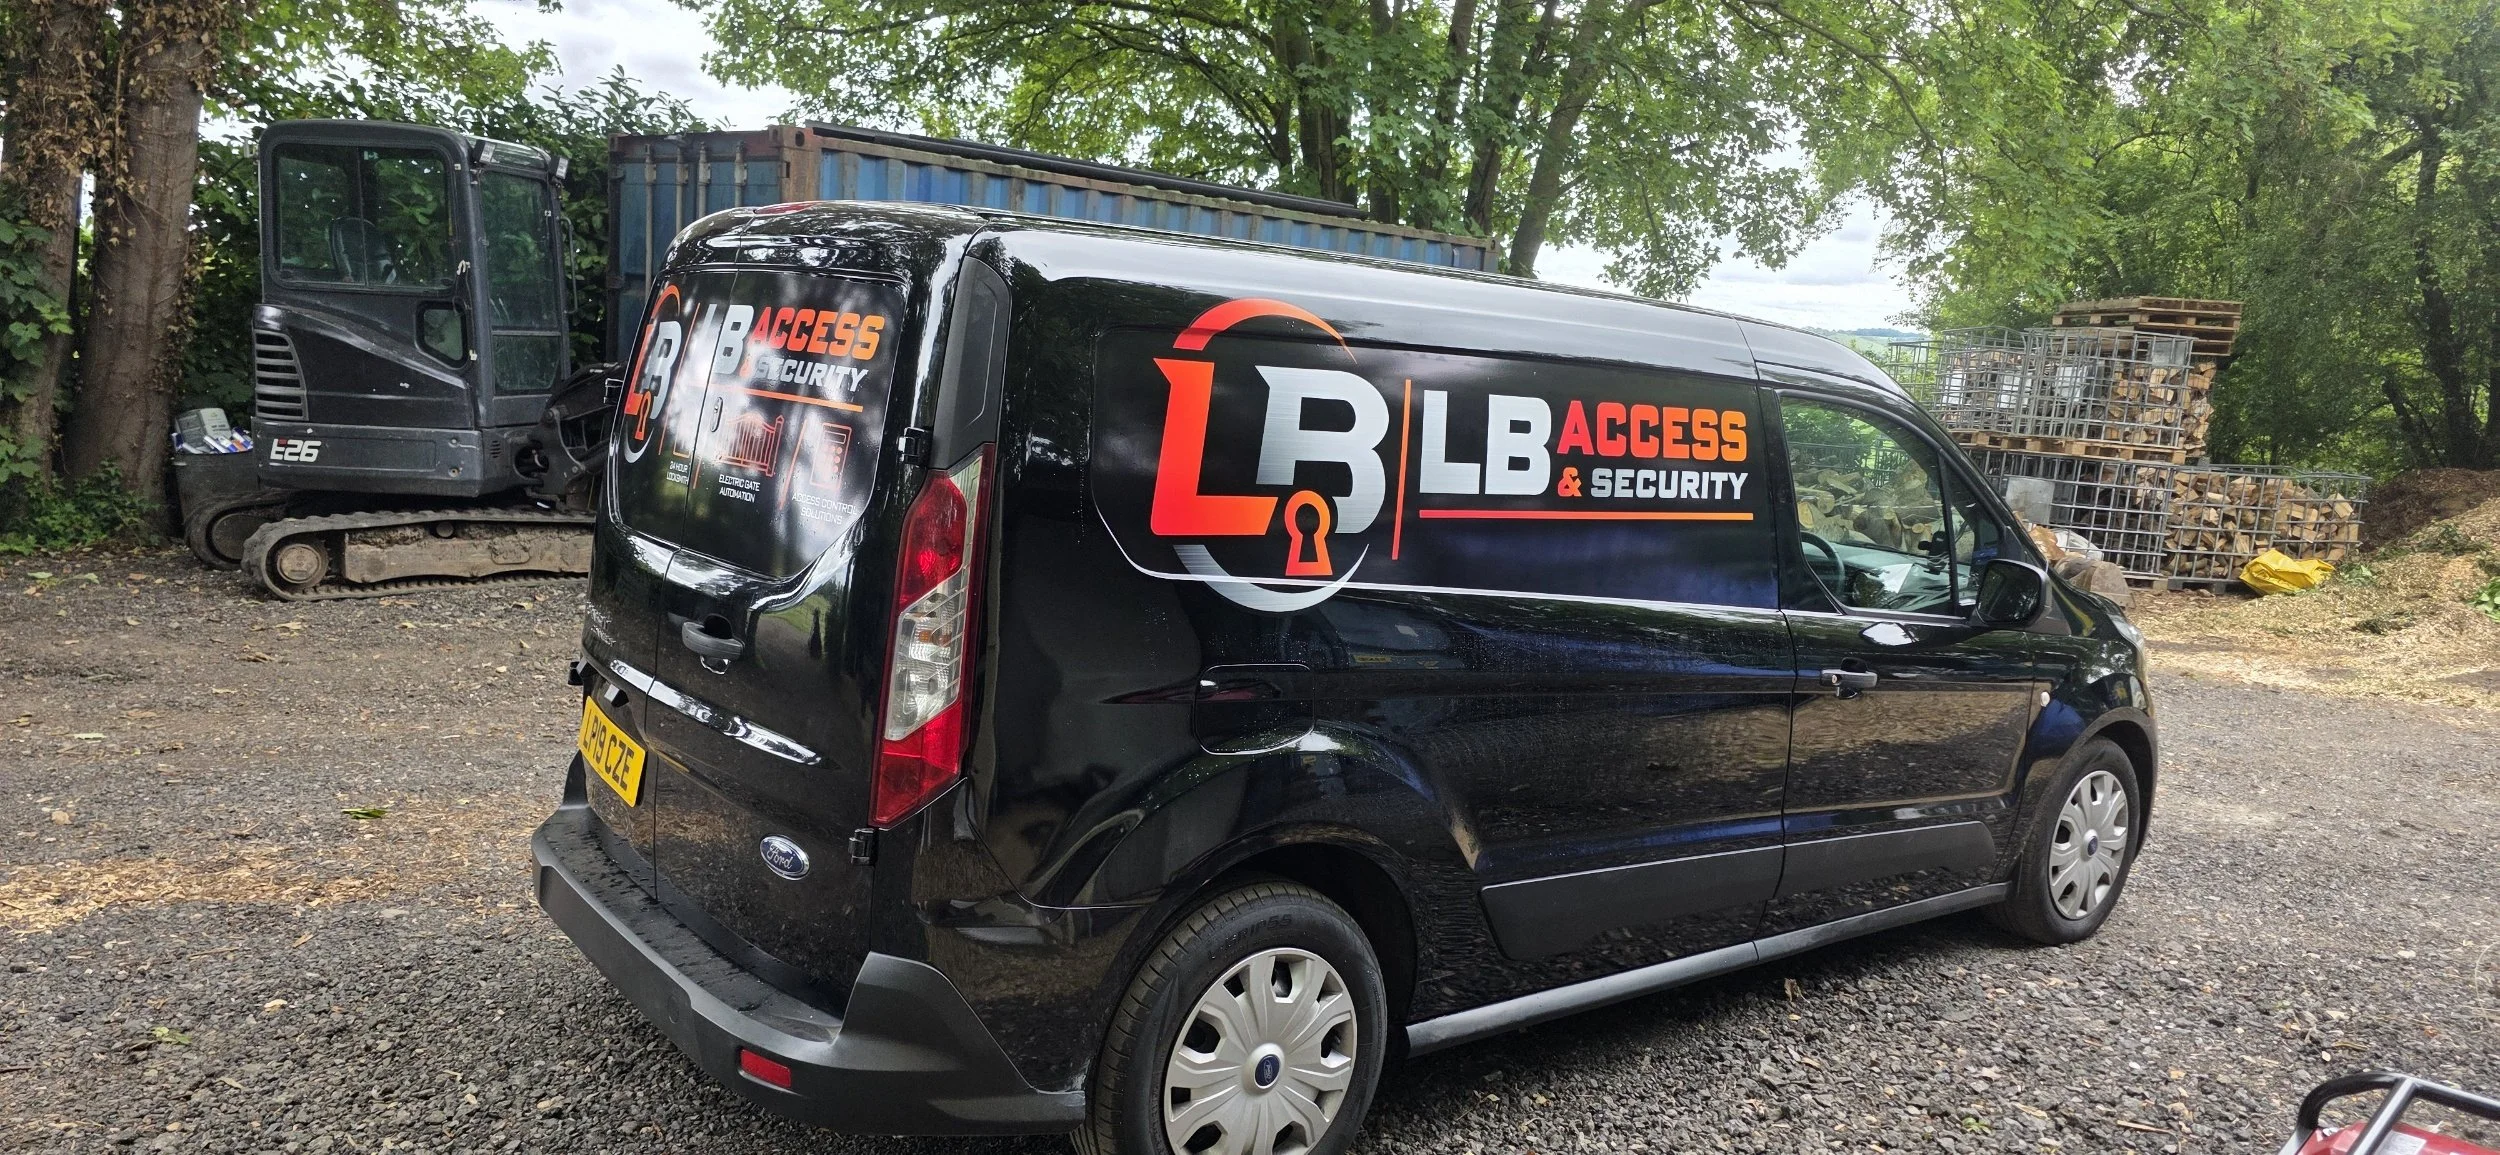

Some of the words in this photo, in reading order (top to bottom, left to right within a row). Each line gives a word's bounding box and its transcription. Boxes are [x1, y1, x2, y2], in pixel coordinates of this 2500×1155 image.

[748, 306, 886, 361] ACCESS
[755, 355, 869, 392] SECURITY
[270, 438, 322, 462] E26
[1150, 357, 1390, 536] LB
[1419, 389, 1552, 495] LB
[1556, 400, 1747, 462] ACCESS
[675, 461, 688, 473] HOUR
[719, 474, 744, 488] ELECTRIC
[744, 480, 760, 491] GATE
[719, 486, 755, 503] AUTOMATION
[1557, 466, 1582, 497] &
[1590, 467, 1748, 500] SECURITY
[792, 493, 820, 507] ACCESS
[821, 499, 857, 515] CONTROL
[801, 507, 842, 525] SOLUTIONS
[583, 708, 607, 765] LP19
[604, 734, 635, 792] CZE
[767, 843, 794, 870] Ford
